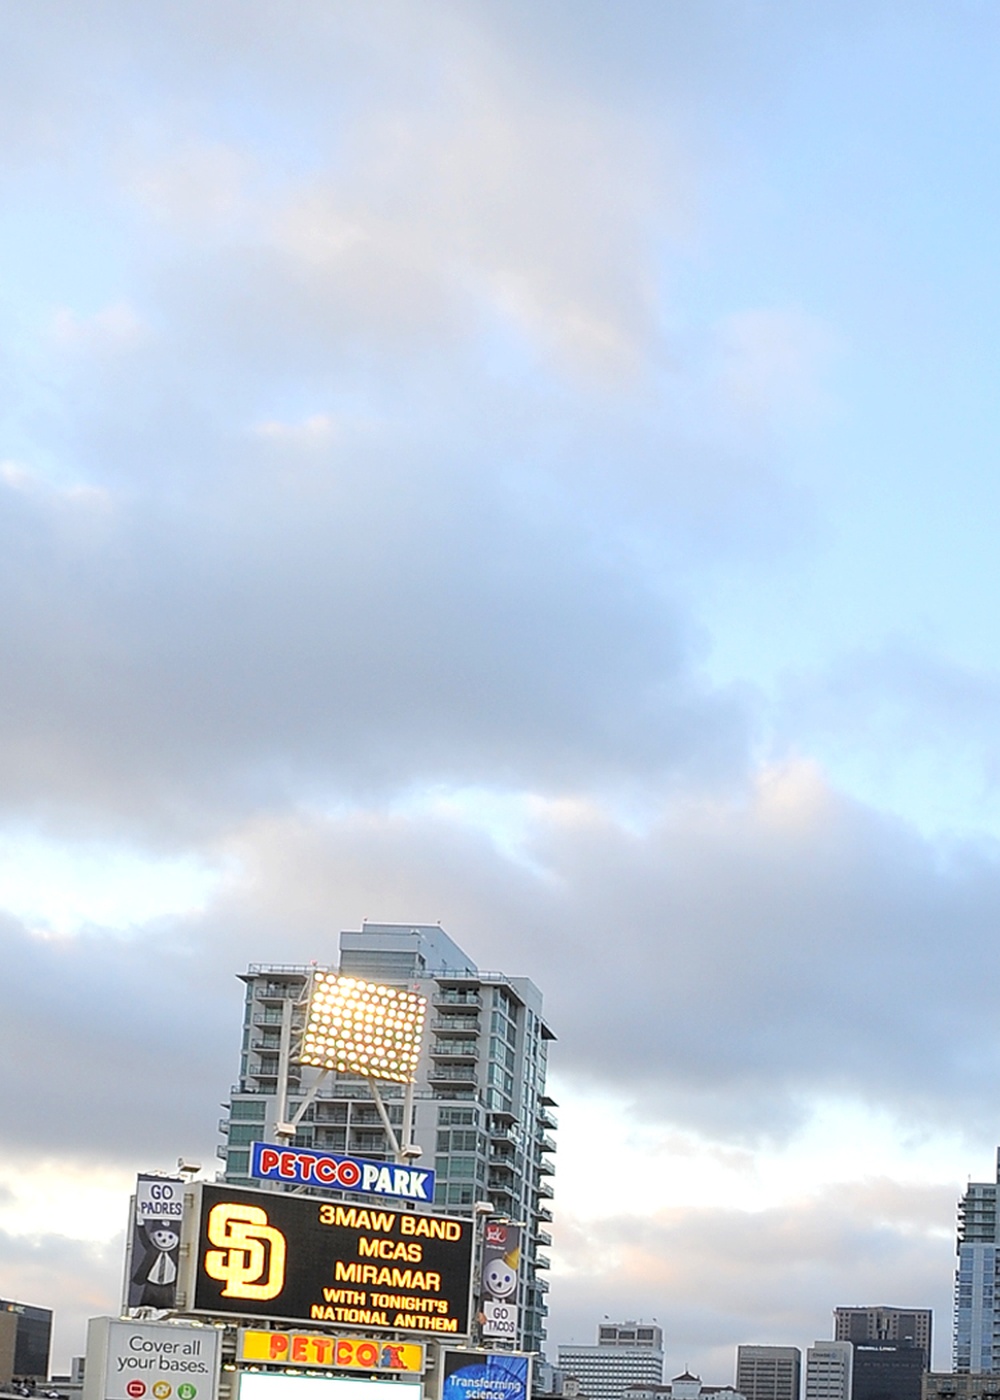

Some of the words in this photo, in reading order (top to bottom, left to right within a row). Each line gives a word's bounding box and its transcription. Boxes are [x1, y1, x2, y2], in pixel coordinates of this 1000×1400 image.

[260, 1150, 360, 1186] PETCO
[362, 1164, 428, 1199] PARK
[151, 1184, 174, 1200] GO
[141, 1202, 182, 1216] PADRES
[320, 1204, 396, 1232] 3MAW
[401, 1216, 462, 1242] BAND
[358, 1238, 422, 1262] MCAS
[335, 1261, 441, 1292] MIRAMAR
[323, 1288, 366, 1306] WITH
[370, 1293, 448, 1314] TONIGHT'S
[311, 1304, 390, 1326] NATIONAL
[394, 1313, 458, 1332] ANTHEM
[493, 1308, 508, 1319] GO
[488, 1320, 514, 1333] TACOS
[129, 1336, 179, 1354] Cover
[182, 1340, 201, 1356] all
[269, 1334, 378, 1368] PETCO
[117, 1356, 156, 1372] your
[159, 1354, 208, 1373] bases.
[450, 1375, 521, 1393] Transforming
[466, 1390, 505, 1400] science
